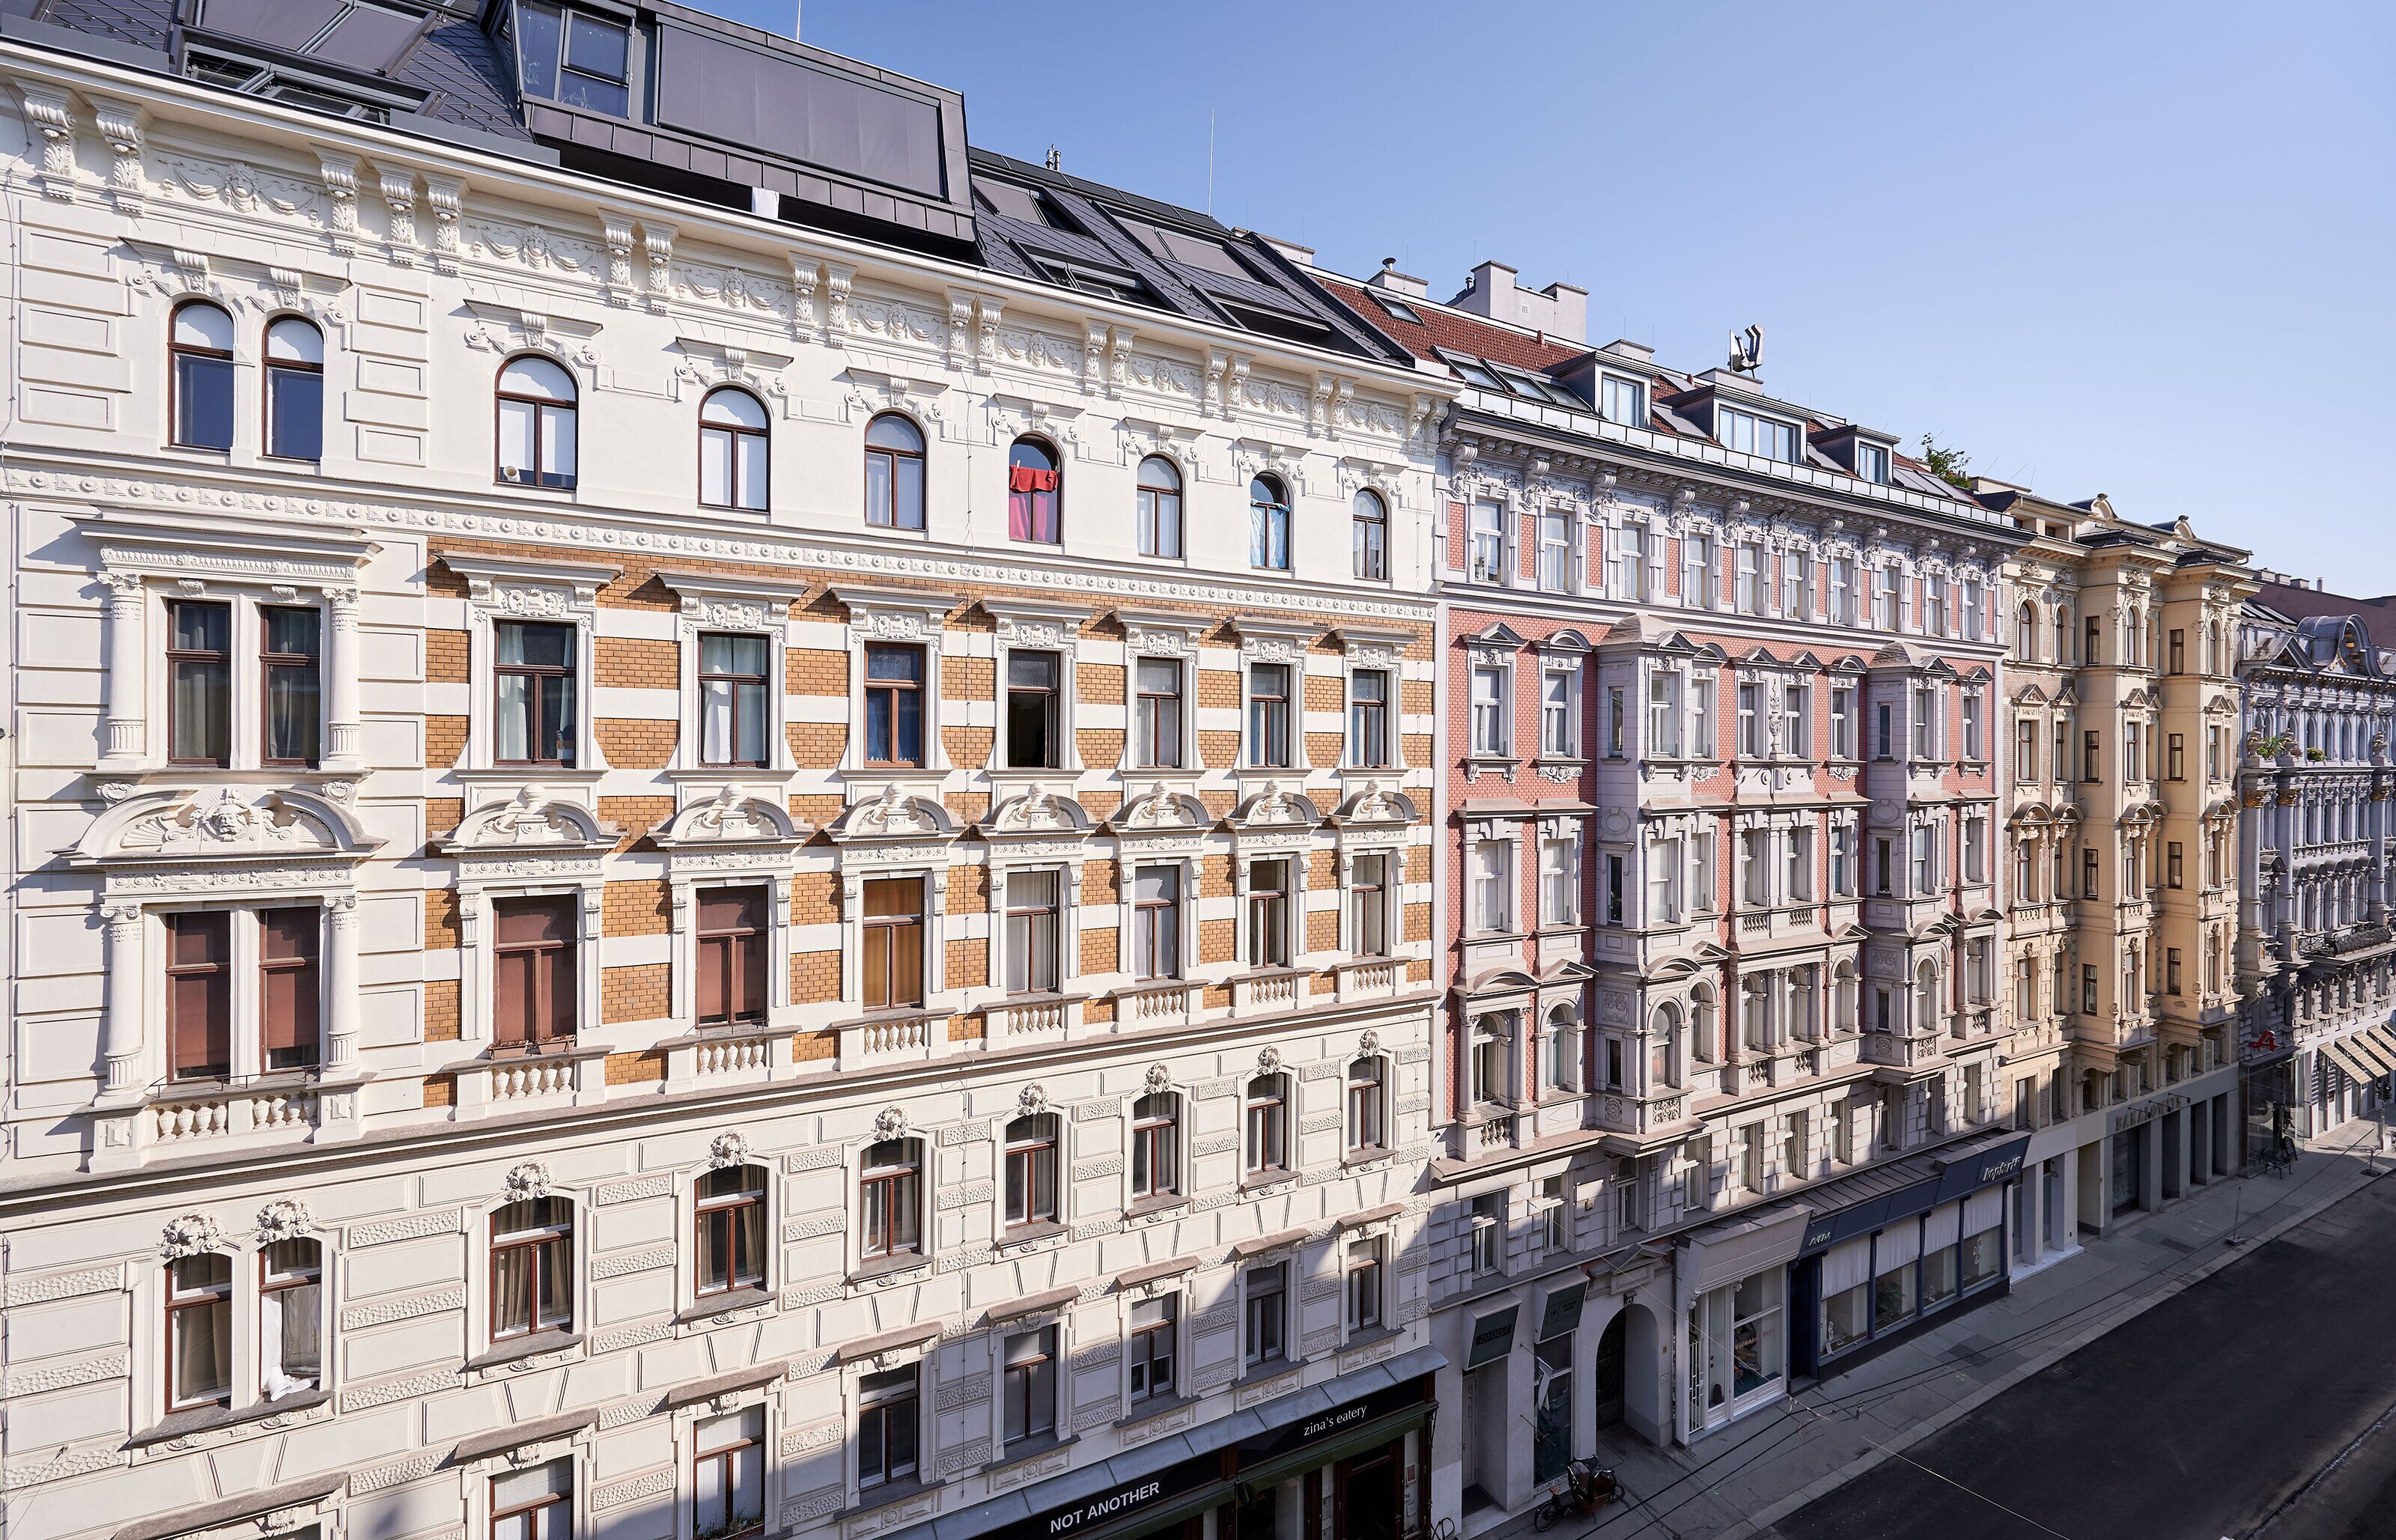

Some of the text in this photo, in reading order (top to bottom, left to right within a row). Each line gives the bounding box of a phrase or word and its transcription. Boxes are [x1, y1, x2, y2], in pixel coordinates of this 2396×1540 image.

[1304, 1405, 1367, 1437] zina's eatery
[1050, 1482, 1160, 1533] NOT ANOTHER
